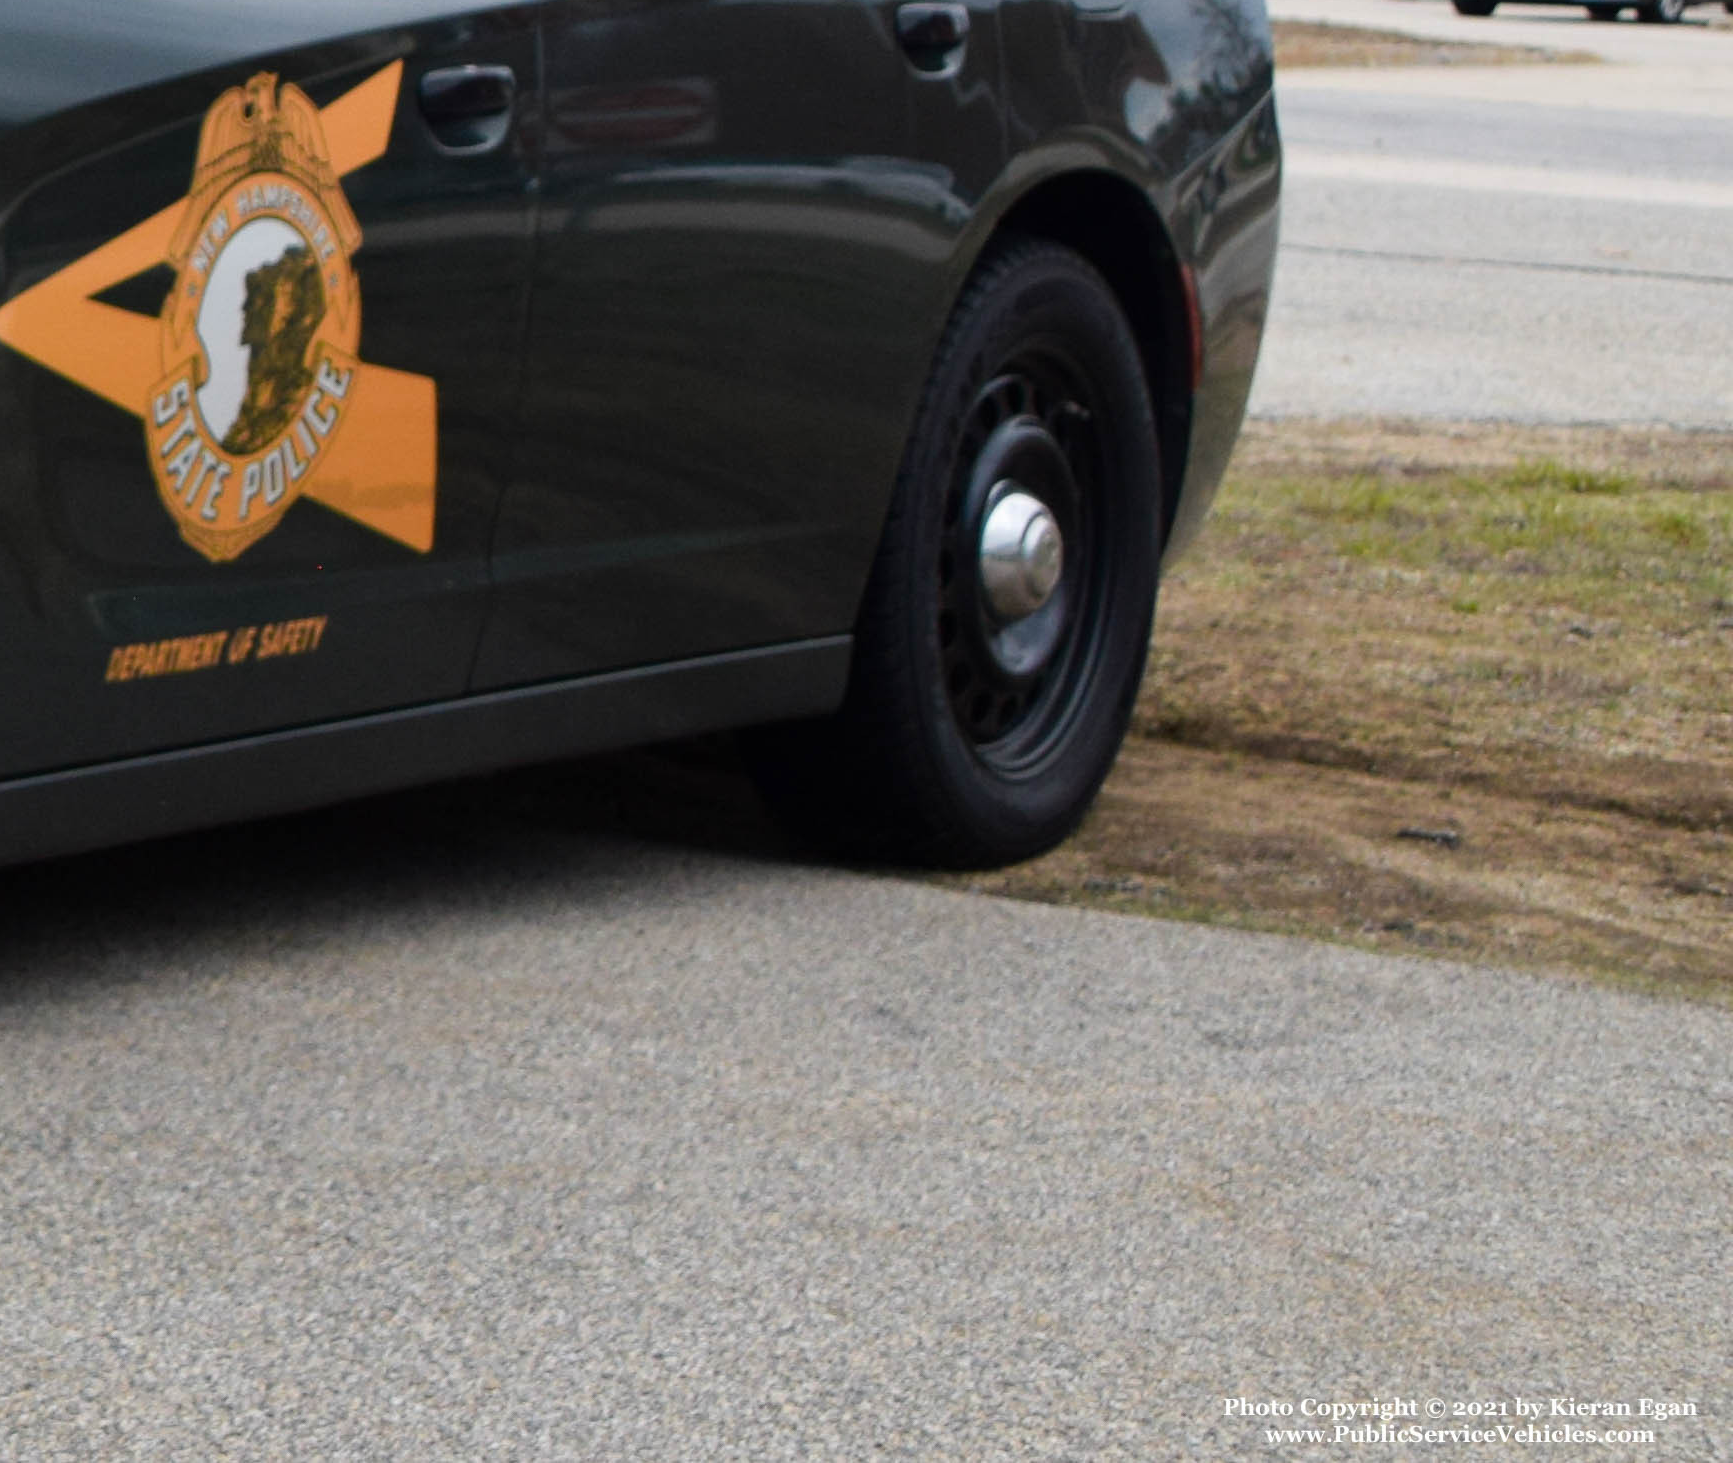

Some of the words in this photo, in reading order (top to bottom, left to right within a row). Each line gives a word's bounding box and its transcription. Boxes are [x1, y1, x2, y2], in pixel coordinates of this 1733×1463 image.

[153, 376, 232, 521] STATE
[237, 356, 354, 521] POLICE
[105, 630, 230, 683] DEPARTMENT
[228, 625, 258, 665] OF
[256, 615, 329, 662] SAFETY
